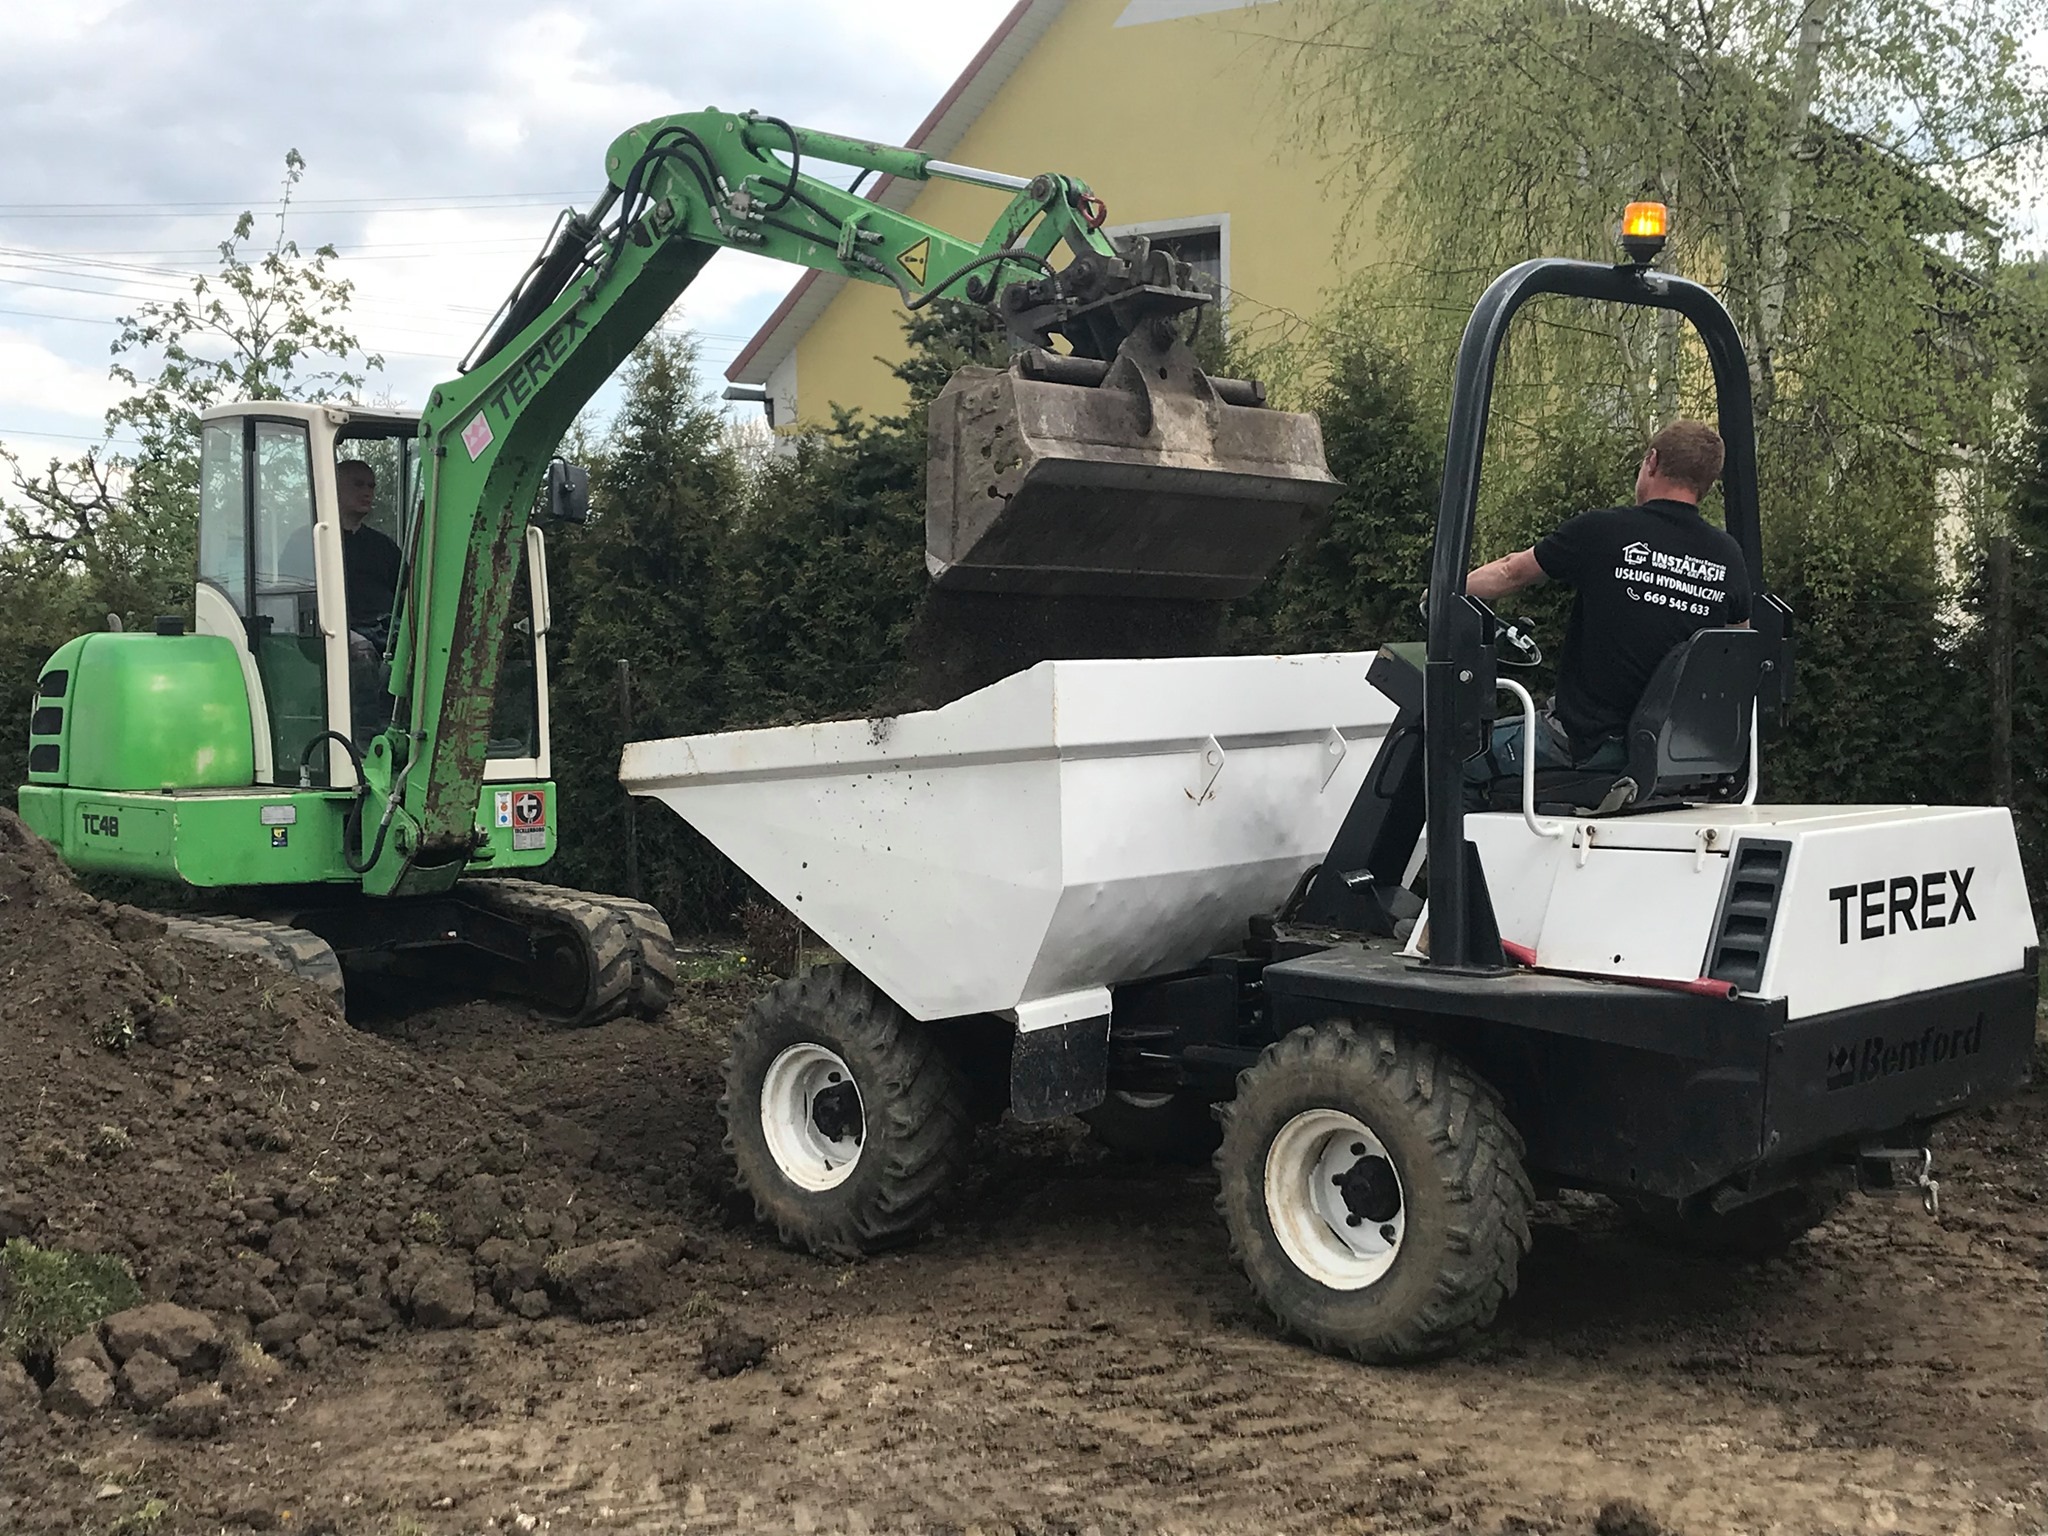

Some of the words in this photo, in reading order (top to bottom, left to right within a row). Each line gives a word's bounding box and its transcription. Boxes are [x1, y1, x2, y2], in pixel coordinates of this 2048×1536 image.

[490, 310, 589, 421] TEREX
[1652, 551, 1726, 581] INSTALACJE
[1614, 567, 1654, 584] USŁUGI
[1656, 574, 1726, 602] HYDRAULICZNE
[1643, 591, 1667, 605] 669
[1668, 597, 1688, 611] 545
[1689, 603, 1710, 616] 633
[82, 813, 119, 838] TC48
[1828, 866, 1977, 945] TEREX
[1859, 1011, 1985, 1084] Benford
